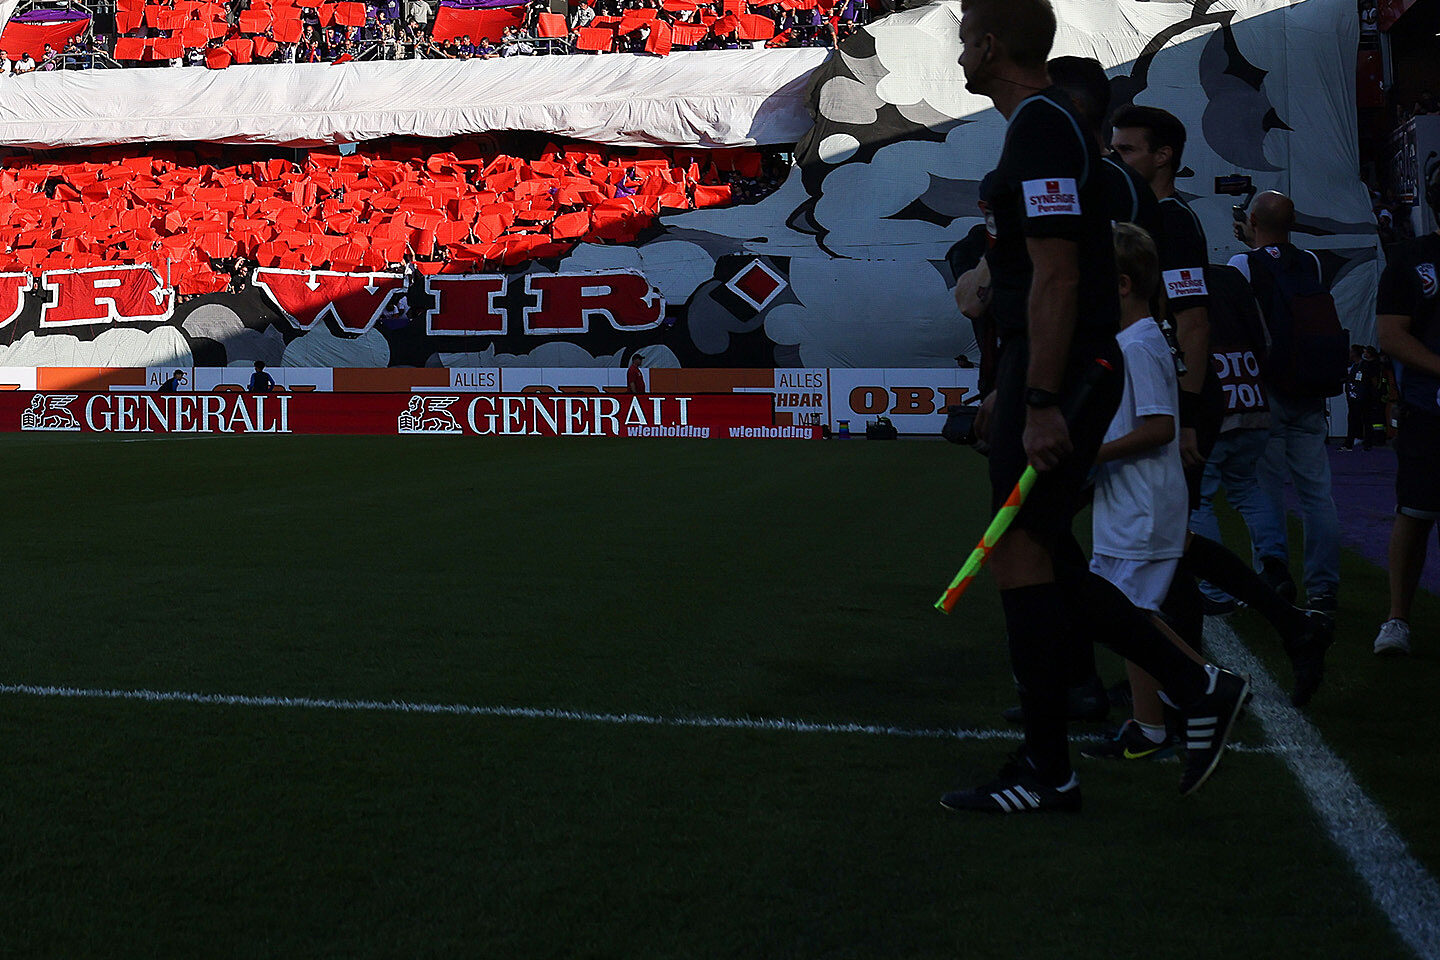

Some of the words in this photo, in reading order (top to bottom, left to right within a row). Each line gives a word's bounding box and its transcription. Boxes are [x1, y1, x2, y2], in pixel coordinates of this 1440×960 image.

[252, 267, 666, 335] WIR
[454, 373, 495, 387] ALLES
[780, 373, 823, 387] ALLES
[85, 394, 293, 433] GENERALI
[773, 393, 823, 407] HBAR
[849, 386, 970, 414] OBI
[467, 396, 692, 436] GENERALI
